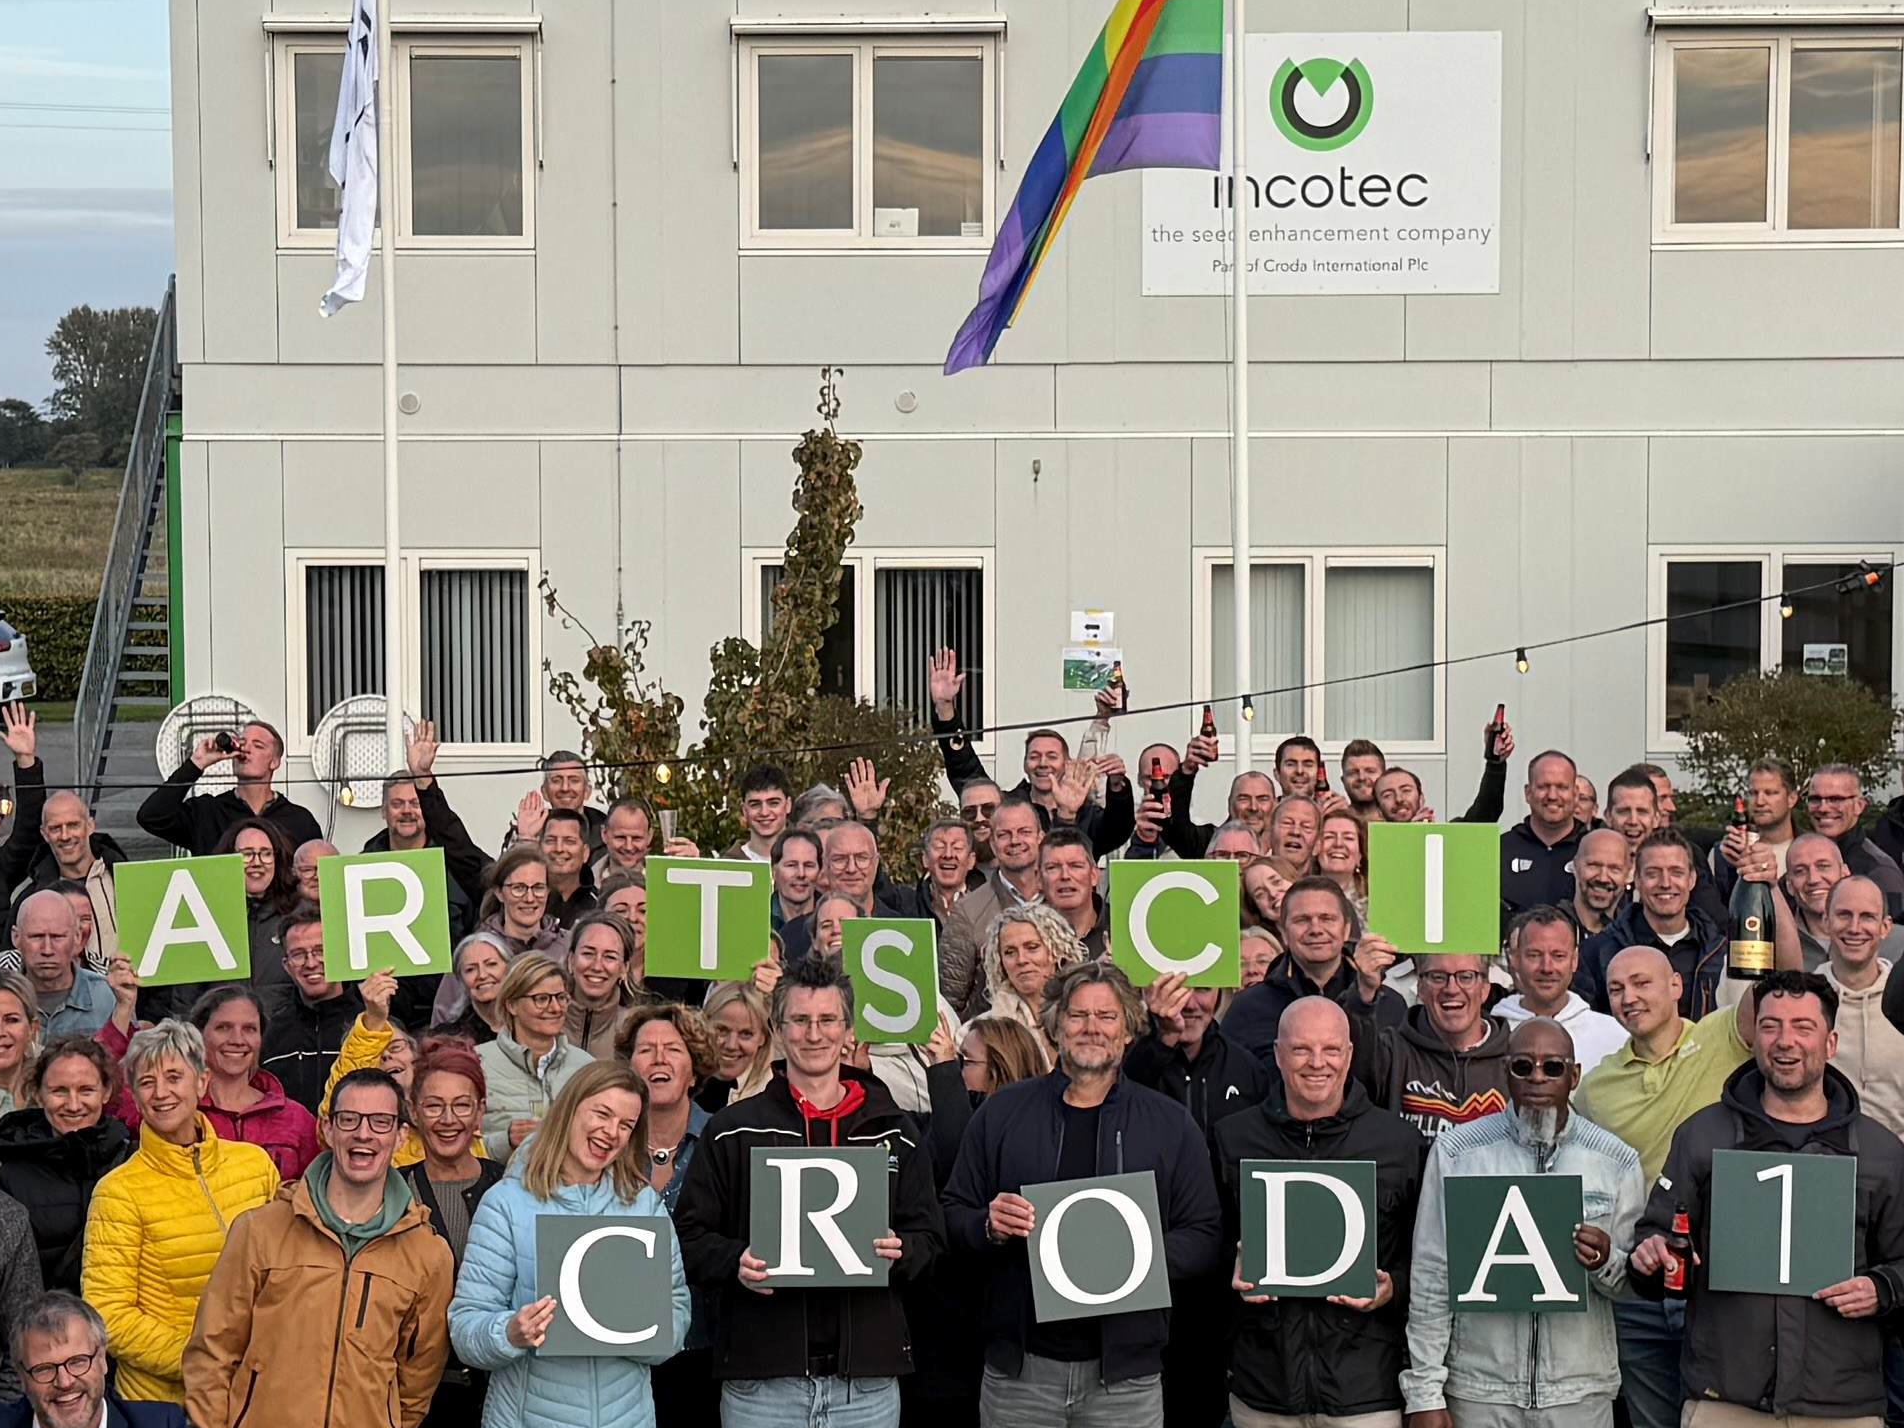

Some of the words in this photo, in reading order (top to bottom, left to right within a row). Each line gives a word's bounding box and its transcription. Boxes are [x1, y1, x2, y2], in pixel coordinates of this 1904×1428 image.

[1213, 166, 1429, 209] incotec
[1152, 224, 1184, 243] the
[1249, 223, 1390, 243] enhancement
[1397, 227, 1491, 247] company
[1212, 259, 1235, 273] Par
[1263, 259, 1308, 273] Croda
[1313, 258, 1403, 272] International
[1408, 258, 1430, 271] Plc
[137, 869, 238, 978] A
[343, 861, 432, 971] R
[666, 867, 753, 970] T
[860, 929, 921, 1033] S
[1128, 871, 1222, 977] C
[559, 1225, 659, 1345] C
[765, 1157, 873, 1276] R
[1251, 1170, 1366, 1286] D
[1457, 1185, 1579, 1302] A
